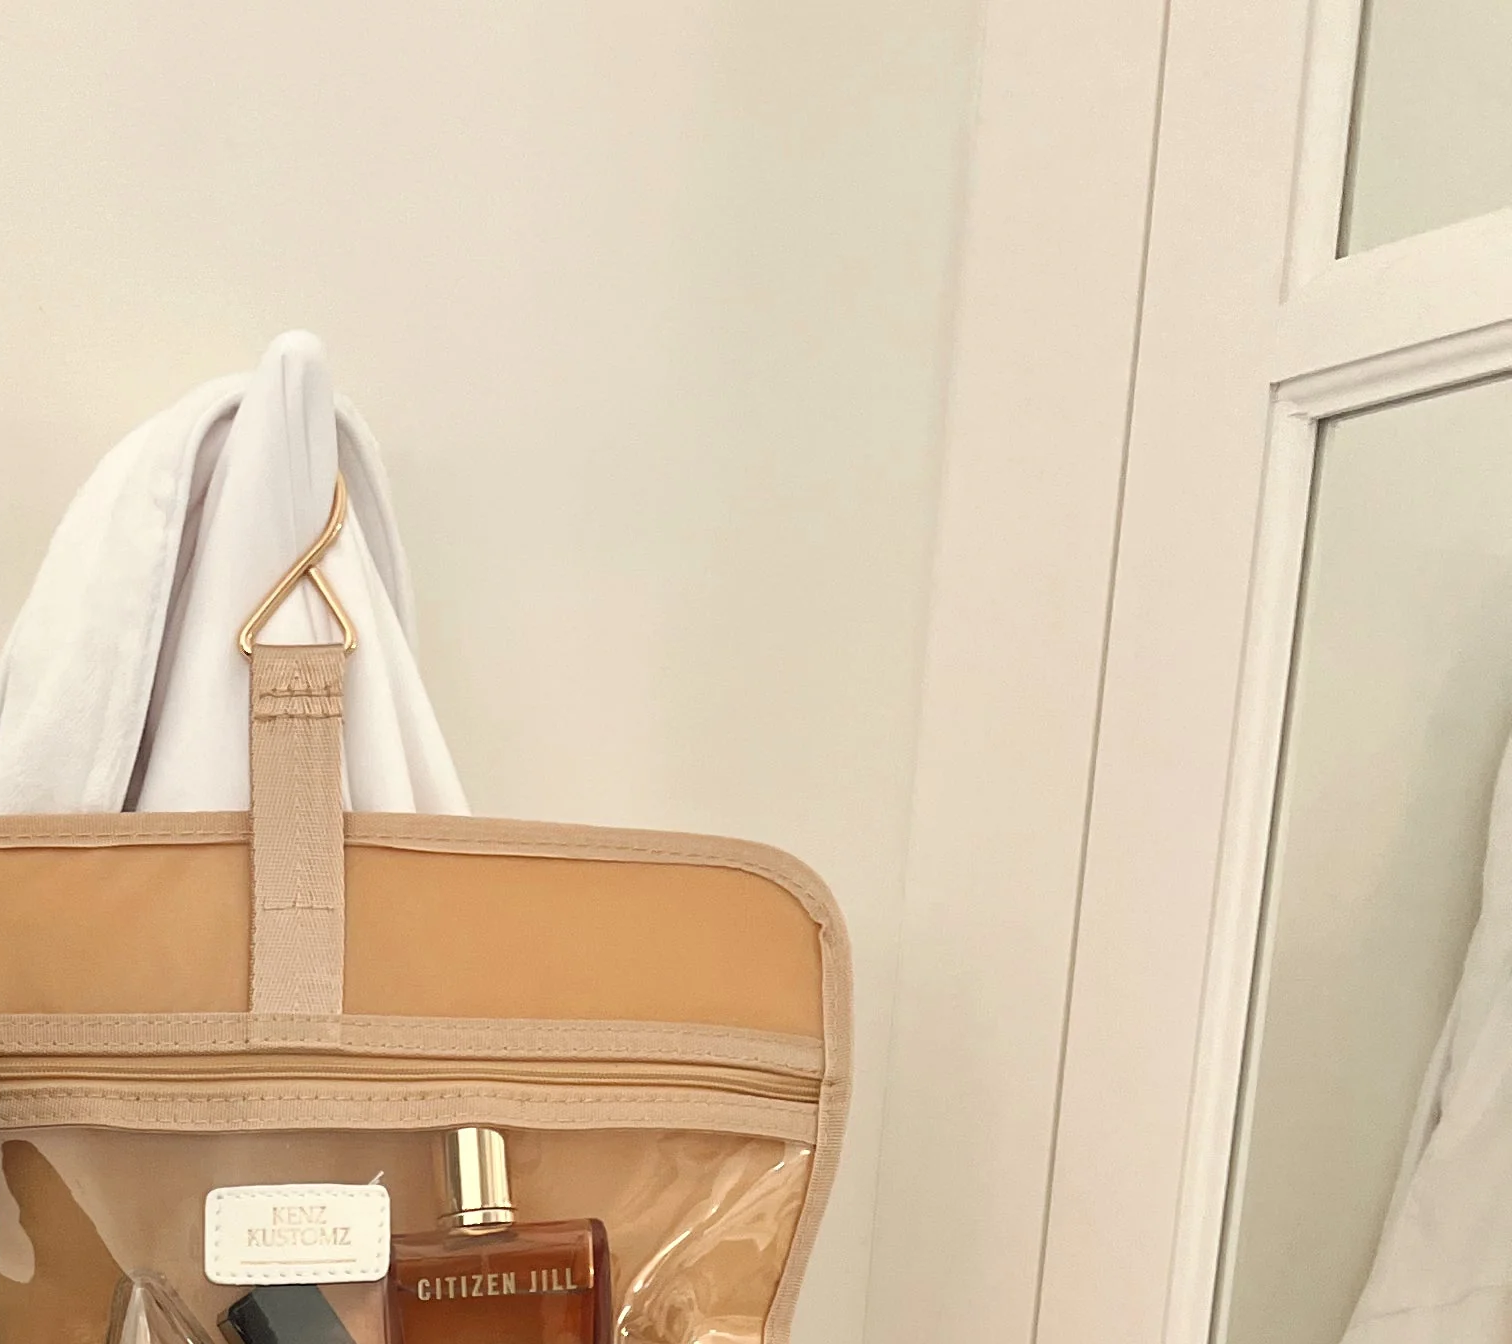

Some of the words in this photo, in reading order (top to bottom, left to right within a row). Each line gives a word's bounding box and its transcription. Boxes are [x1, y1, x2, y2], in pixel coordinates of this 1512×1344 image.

[273, 1206, 327, 1226] KENZ
[247, 1227, 351, 1247] KUSTOMZ
[417, 1272, 516, 1301] CITIZEN
[529, 1267, 578, 1293] JILL
